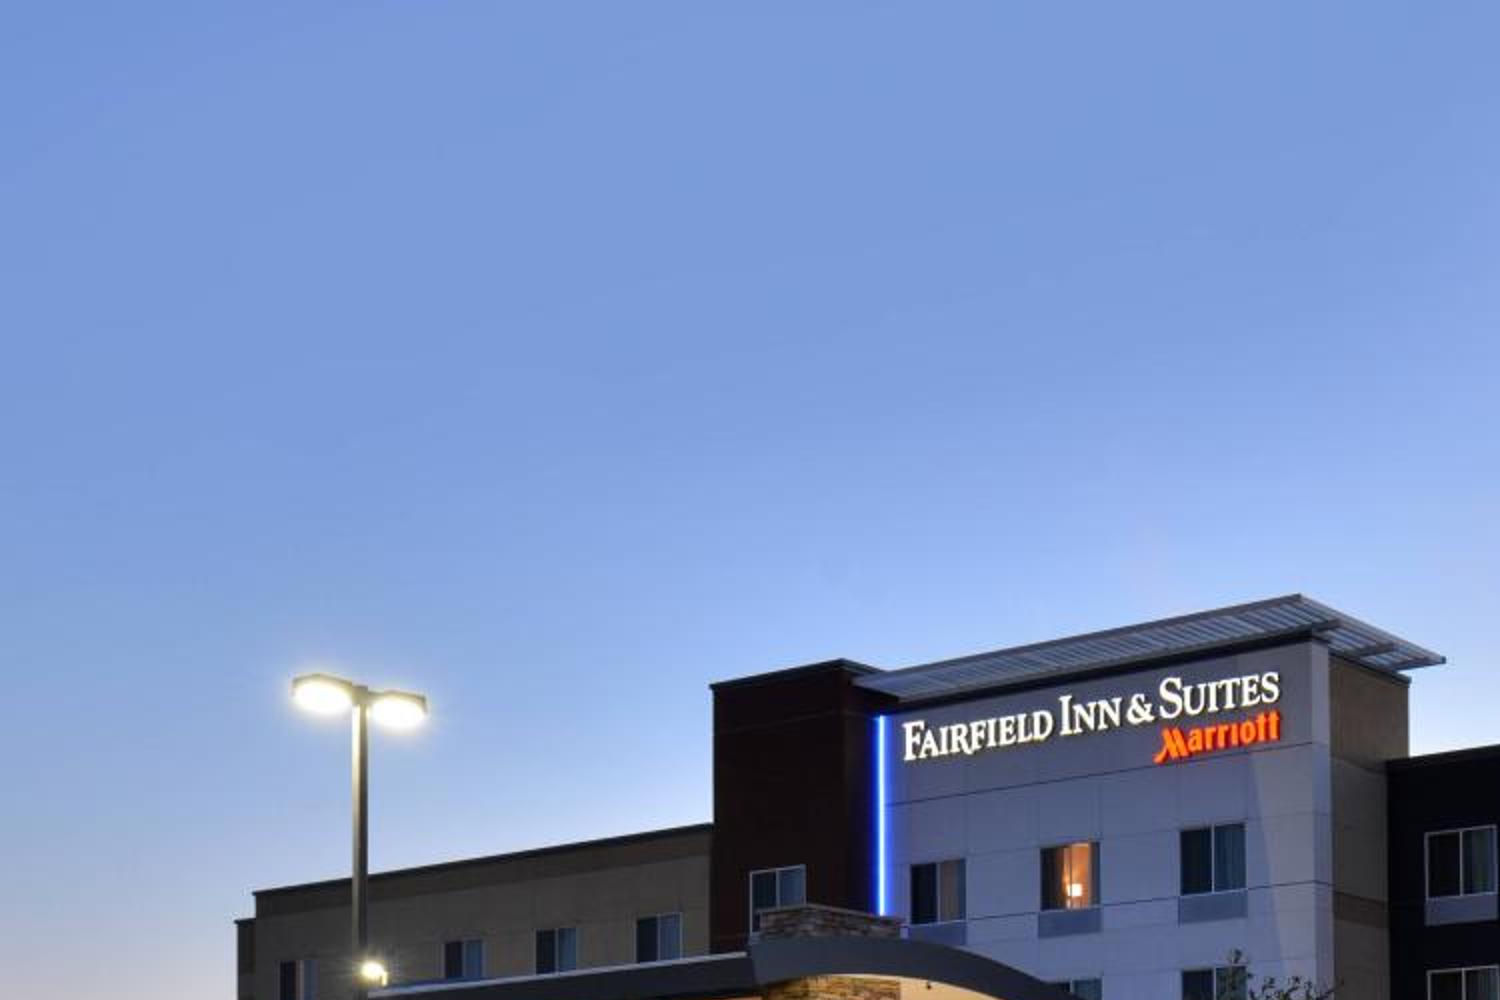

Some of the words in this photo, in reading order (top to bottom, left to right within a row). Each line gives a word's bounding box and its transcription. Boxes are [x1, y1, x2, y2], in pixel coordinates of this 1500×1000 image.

[903, 710, 1054, 762] FAIRFIELD
[1059, 694, 1122, 736] INN
[1126, 693, 1155, 725] &
[1159, 671, 1281, 719] SUITES
[1153, 709, 1281, 765] Marriott
